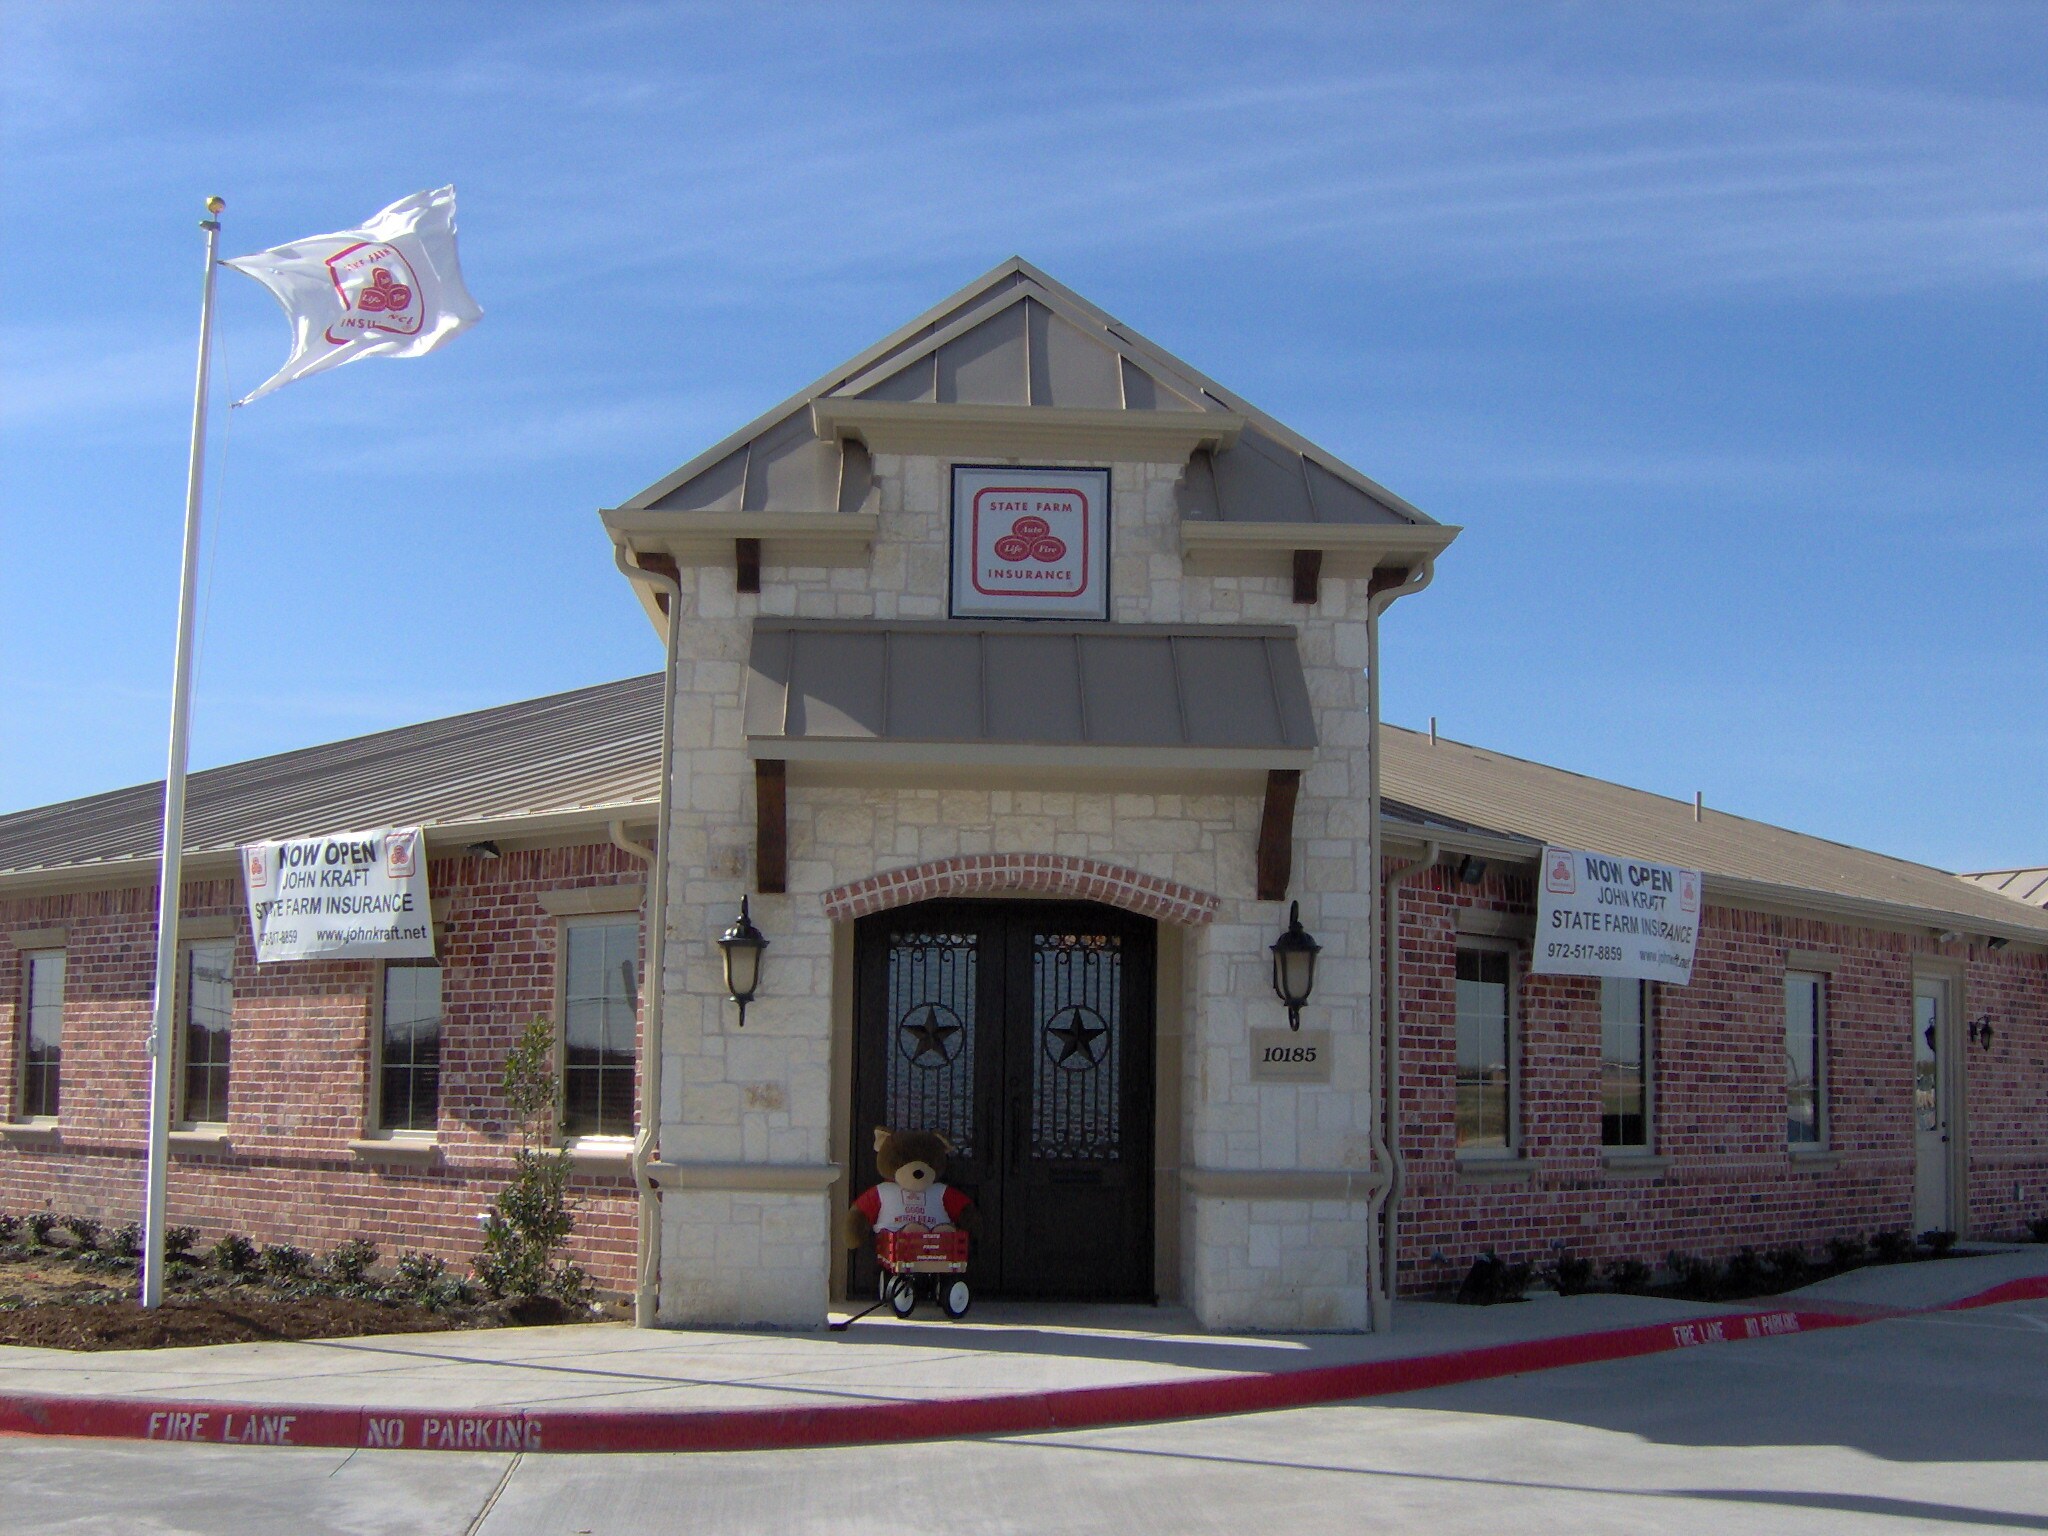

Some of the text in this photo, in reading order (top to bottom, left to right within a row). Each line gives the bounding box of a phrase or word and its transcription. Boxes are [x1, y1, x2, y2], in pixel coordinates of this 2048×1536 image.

[990, 502, 1073, 512] STATE FARM
[1020, 525, 1043, 534] Auto
[1003, 544, 1023, 555] Life
[1038, 544, 1057, 554] Fire
[988, 569, 1072, 580] INSURANCE
[279, 839, 377, 869] NOW OPEN
[282, 868, 370, 890] JOHN KRAFT
[1586, 857, 1673, 893] NOW OPEN
[286, 896, 322, 916] FARM
[326, 893, 414, 915] INSURANCE
[1598, 886, 1629, 908] JOHN
[316, 925, 427, 944] www.johnkraft.net
[1551, 909, 1693, 944] STATE FARM INSURANCE
[1547, 942, 1622, 961] 972-517-8859
[1262, 1047, 1317, 1062] 10185
[1672, 1311, 1800, 1347] FIRE LANE NO PARKING
[146, 1411, 543, 1450] FIRE LANE NO PARKING
